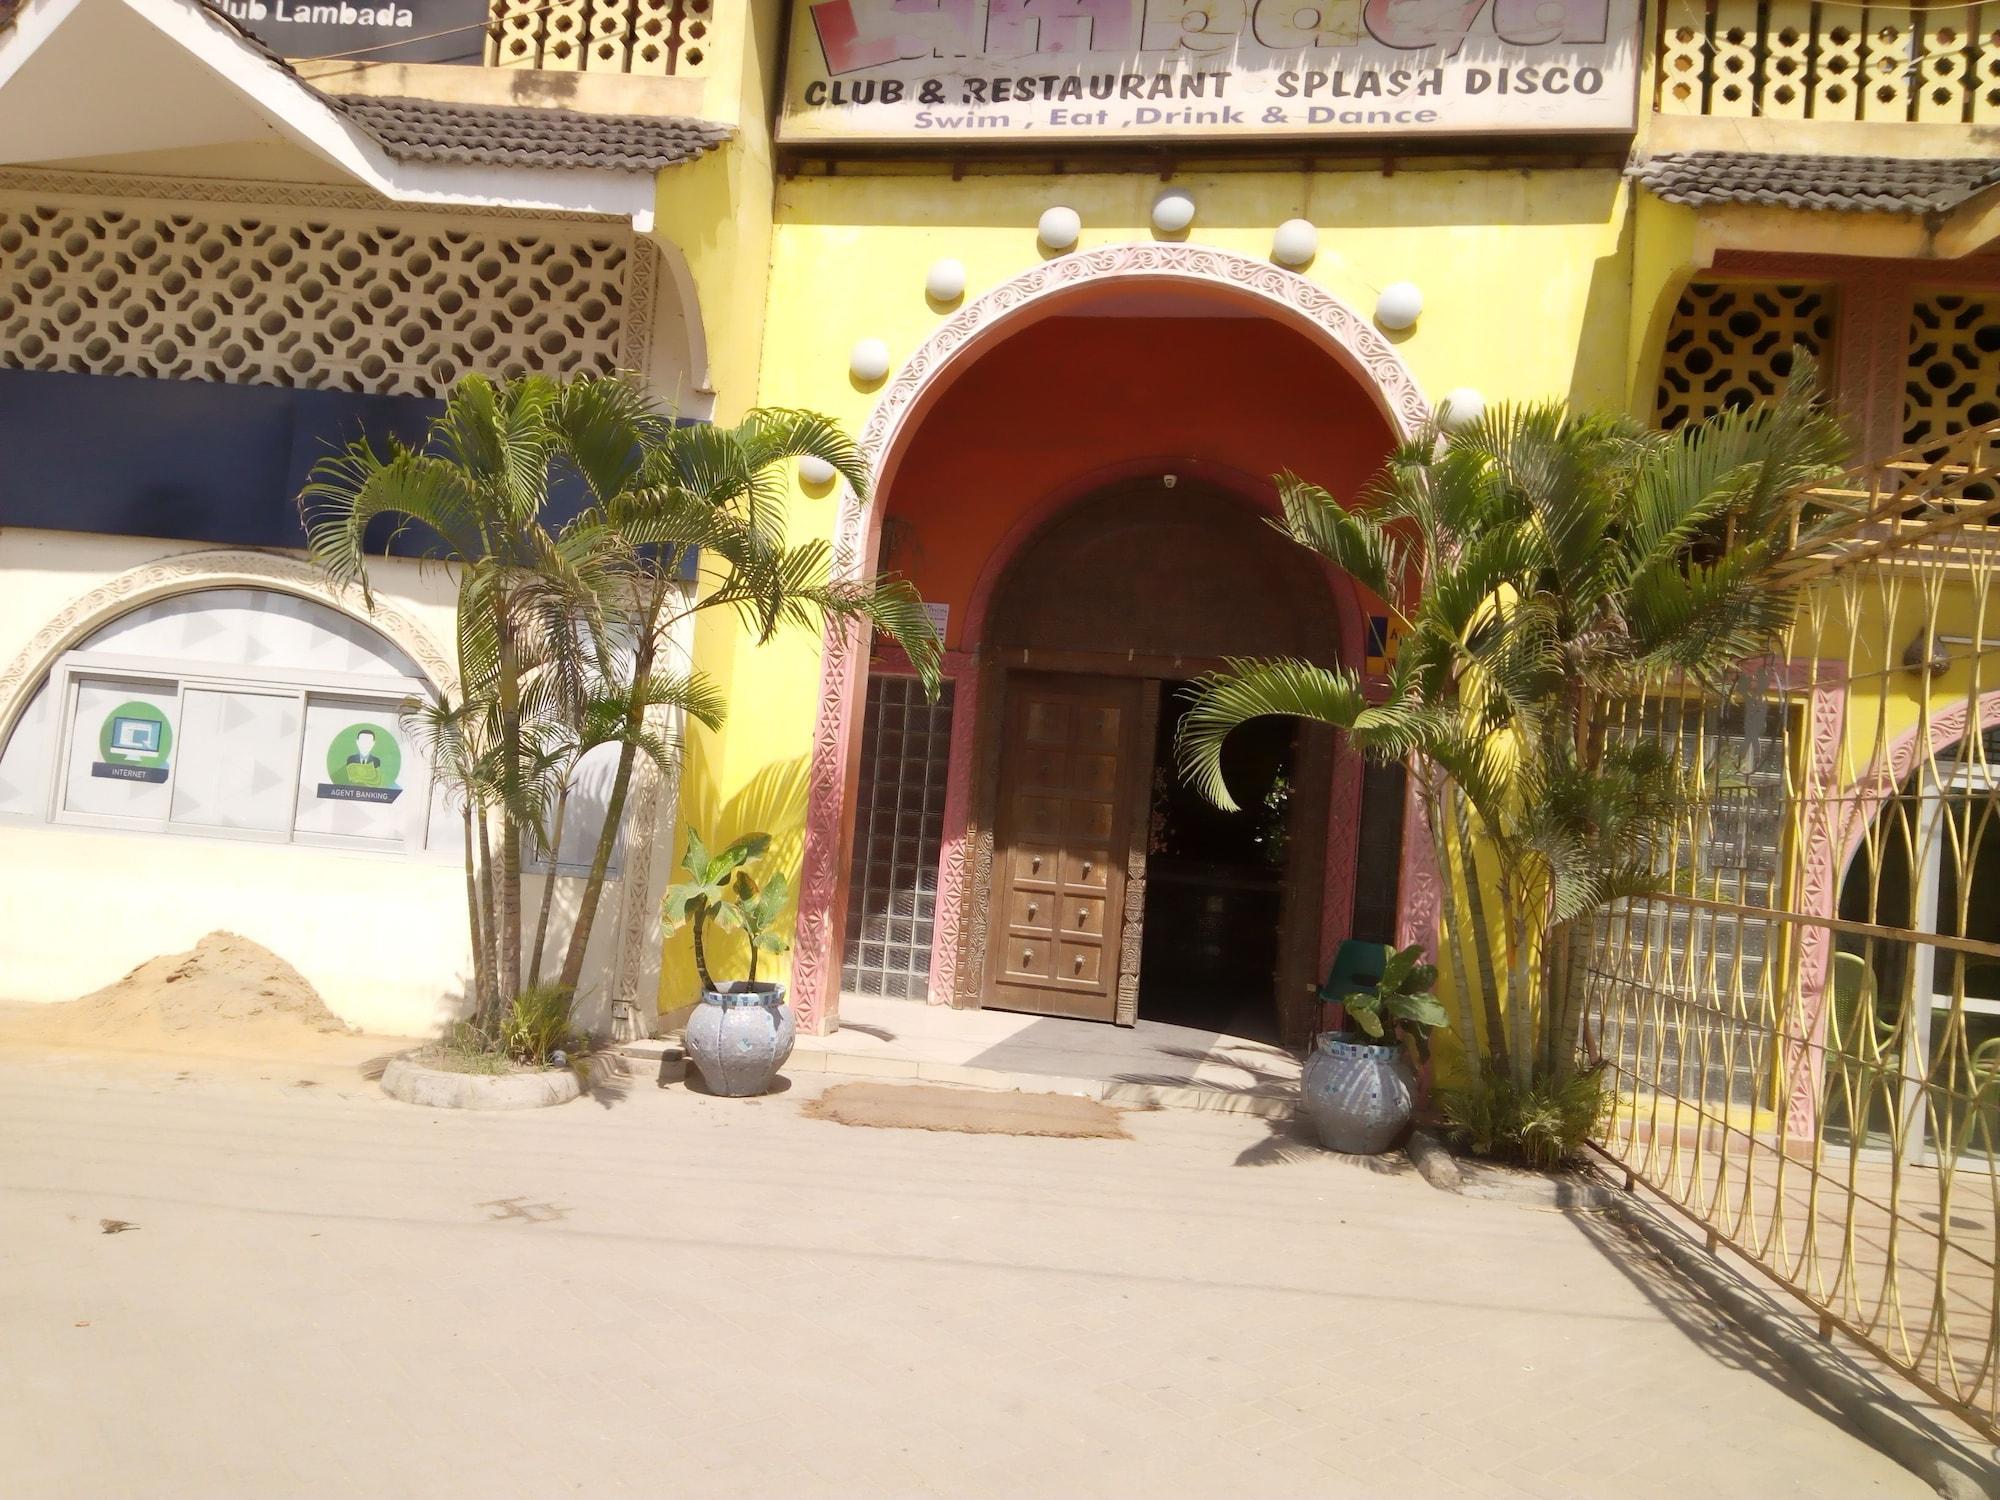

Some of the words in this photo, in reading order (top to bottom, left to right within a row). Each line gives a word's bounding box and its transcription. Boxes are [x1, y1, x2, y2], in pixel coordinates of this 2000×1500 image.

[214, 0, 267, 20] lub
[275, 0, 413, 27] Lambada
[804, 79, 903, 106] CLUB
[918, 79, 944, 105] &
[962, 71, 1232, 104] RESTAURANT
[1275, 67, 1445, 98] SPLASH
[1465, 66, 1603, 95] DISCO
[914, 111, 1009, 129] Swim
[1049, 108, 1110, 126] Eat
[1261, 106, 1287, 124] &
[1307, 106, 1439, 124] Dance
[111, 768, 147, 778] INTERNET
[330, 788, 354, 797] AGENT
[355, 790, 389, 800] BANKING
